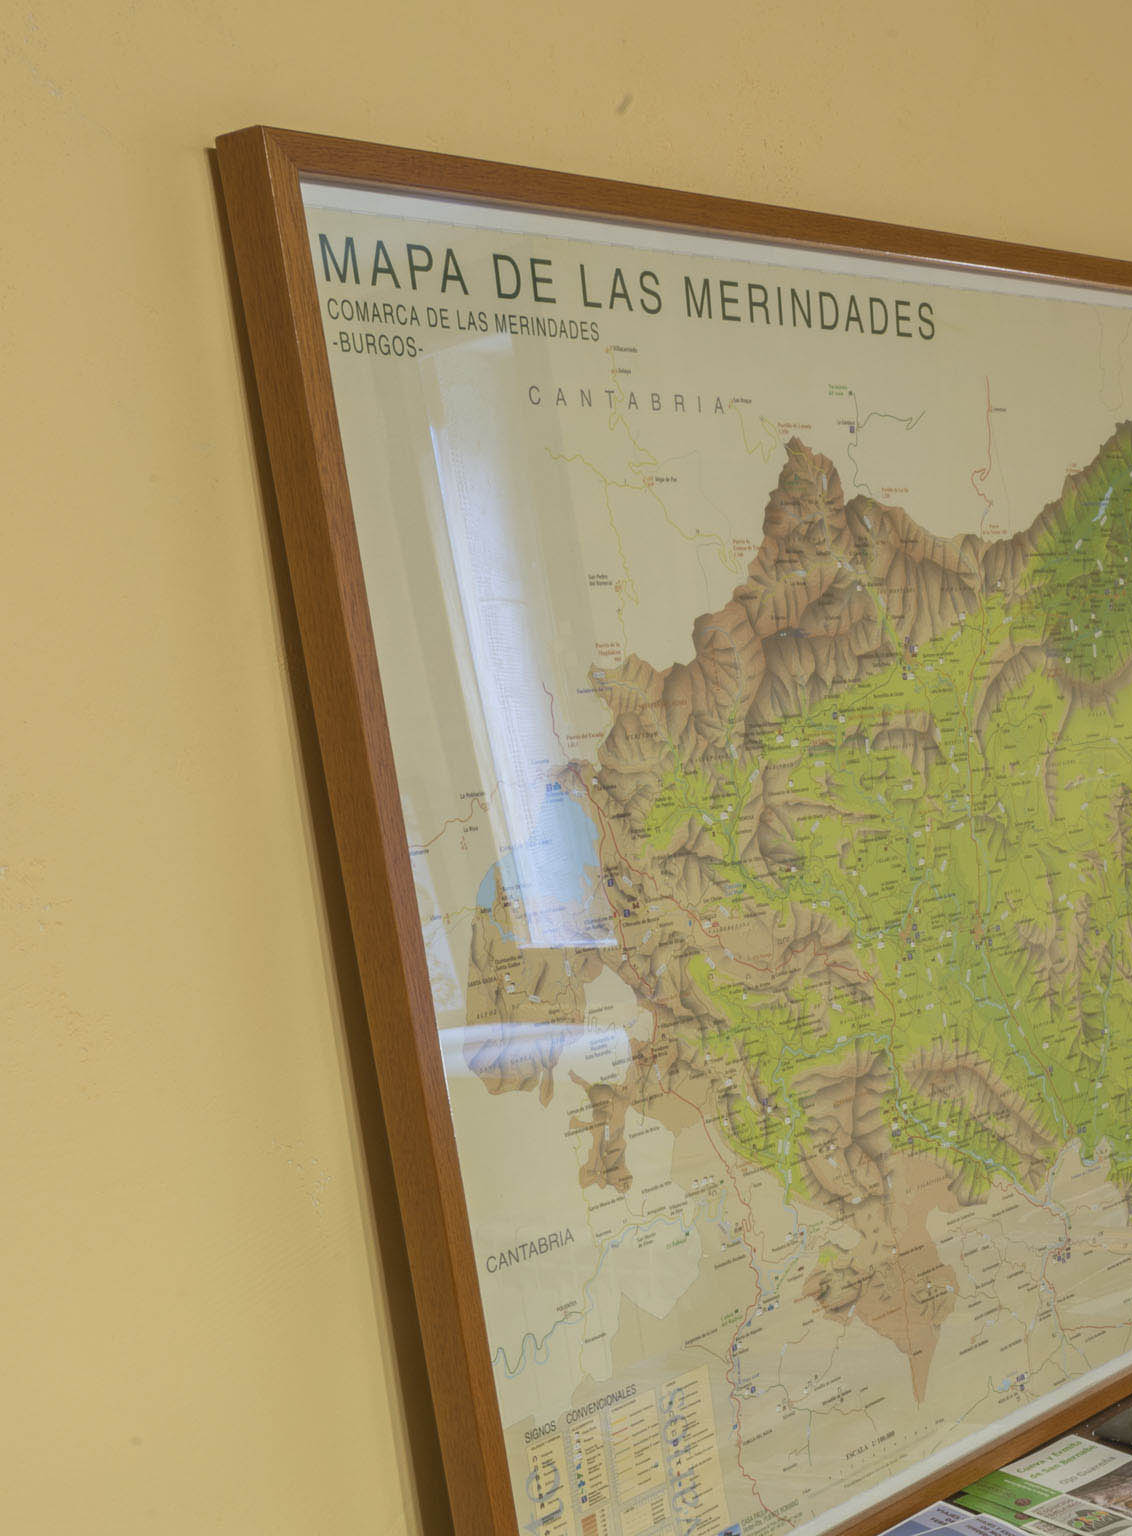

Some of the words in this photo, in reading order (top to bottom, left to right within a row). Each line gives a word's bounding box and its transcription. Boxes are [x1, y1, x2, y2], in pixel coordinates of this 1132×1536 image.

[318, 233, 469, 296] MAPA
[493, 253, 557, 305] DE
[579, 263, 662, 315] LAS
[684, 276, 935, 341] MERINDADES
[327, 298, 421, 327] COMARCA
[426, 306, 450, 329] DE
[456, 310, 488, 333] LAS
[495, 313, 600, 342] MERINDADES
[332, 331, 423, 358] -BURGOS-
[528, 385, 725, 415] CANTABRIA
[486, 1228, 575, 1274] CANTABRIA
[565, 1384, 638, 1426] CONVENCIONALES
[524, 1420, 558, 1445] SIGNOS
